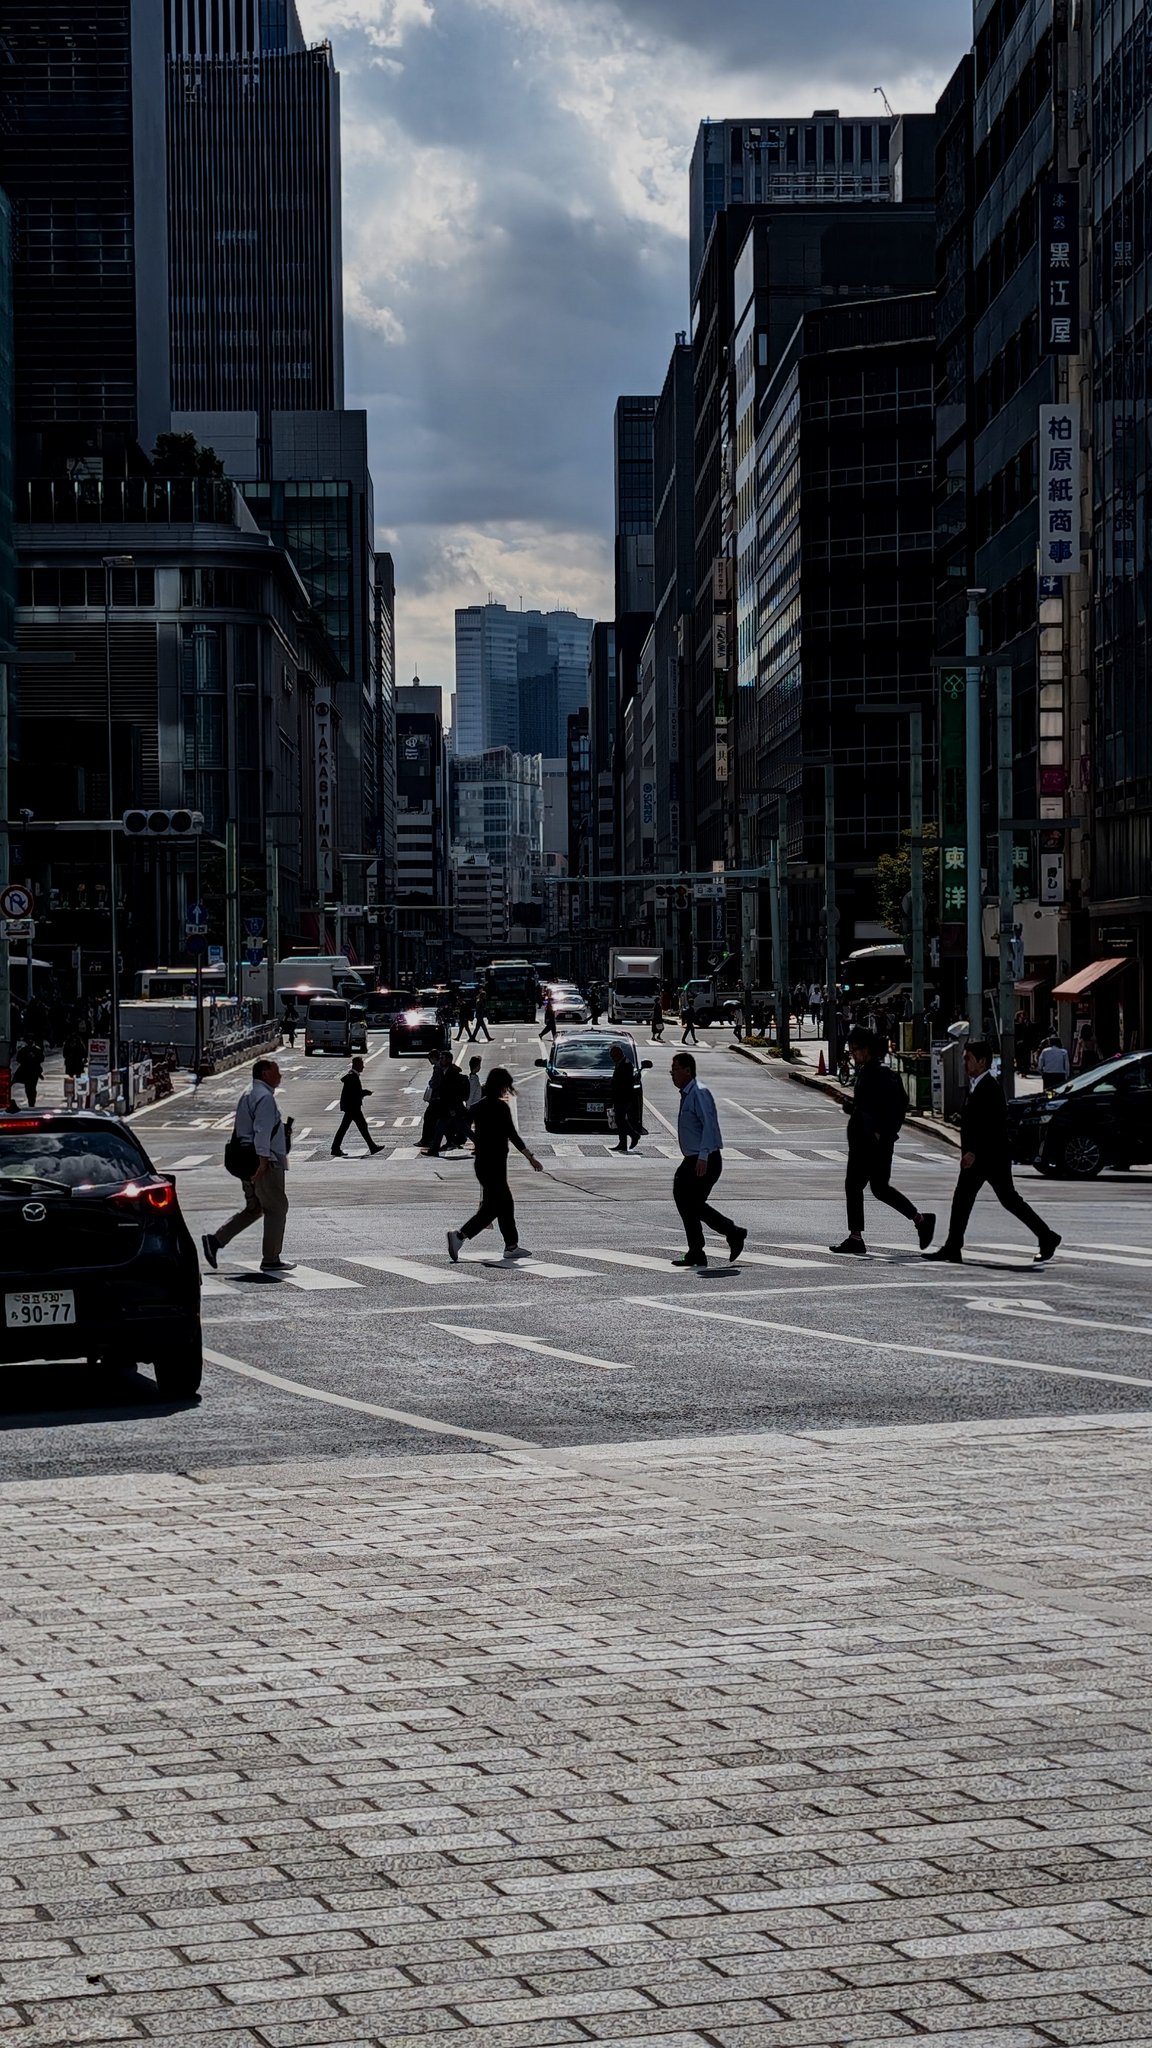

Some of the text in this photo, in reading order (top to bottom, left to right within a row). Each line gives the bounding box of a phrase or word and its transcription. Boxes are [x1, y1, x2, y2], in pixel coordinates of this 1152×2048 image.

[1048, 242, 1072, 343] 黒江屋
[1047, 415, 1073, 564] 柏原紙商事
[944, 846, 966, 909] 東洋
[21, 1303, 71, 1323] 90-77
